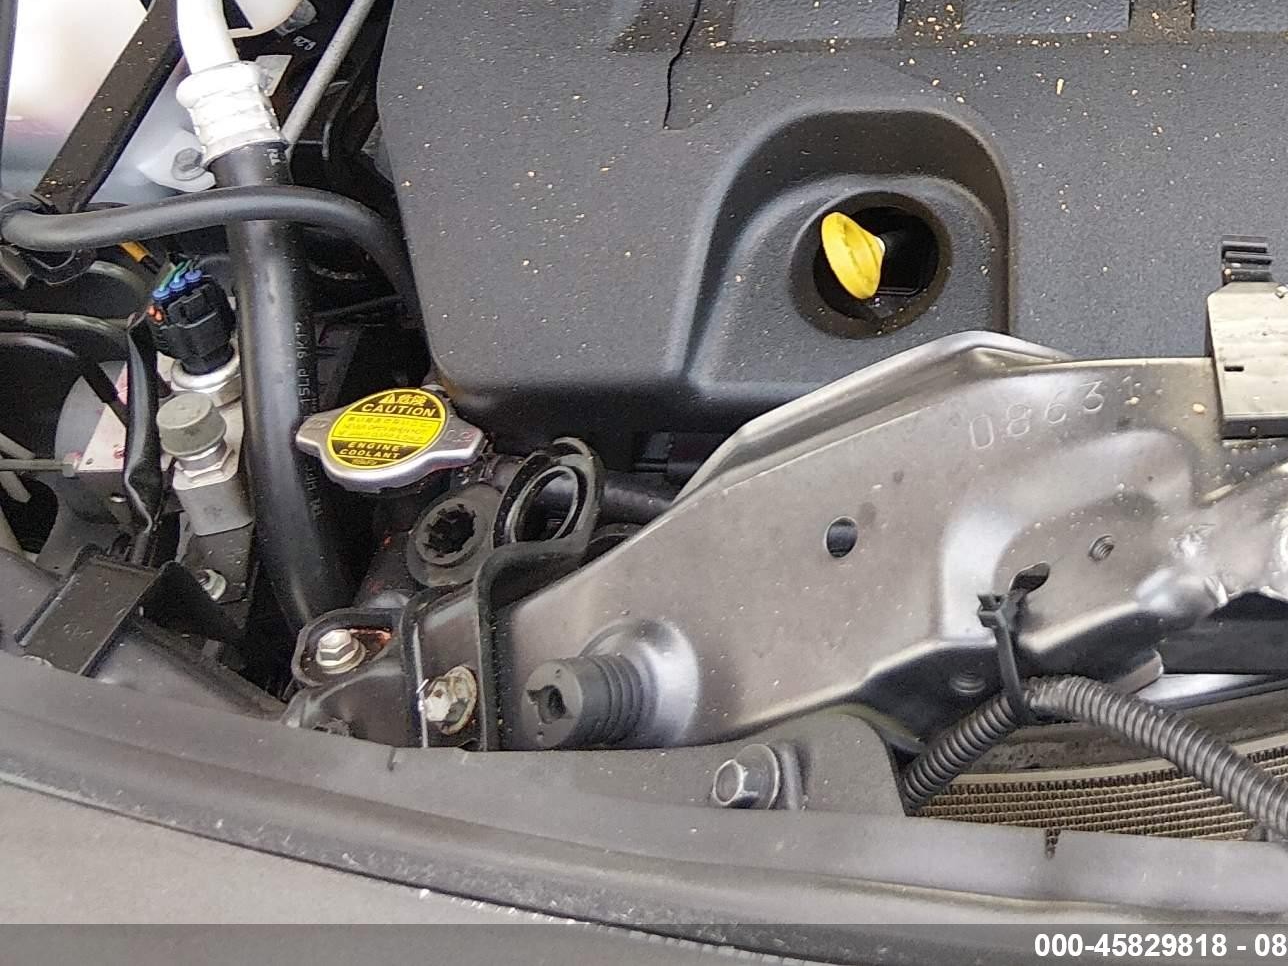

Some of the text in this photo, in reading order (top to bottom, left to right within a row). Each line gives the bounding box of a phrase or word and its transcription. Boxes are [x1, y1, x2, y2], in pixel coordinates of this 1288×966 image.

[361, 403, 437, 417] CAUTION
[347, 441, 401, 452] ENGINE
[339, 448, 401, 459] COOLANT
